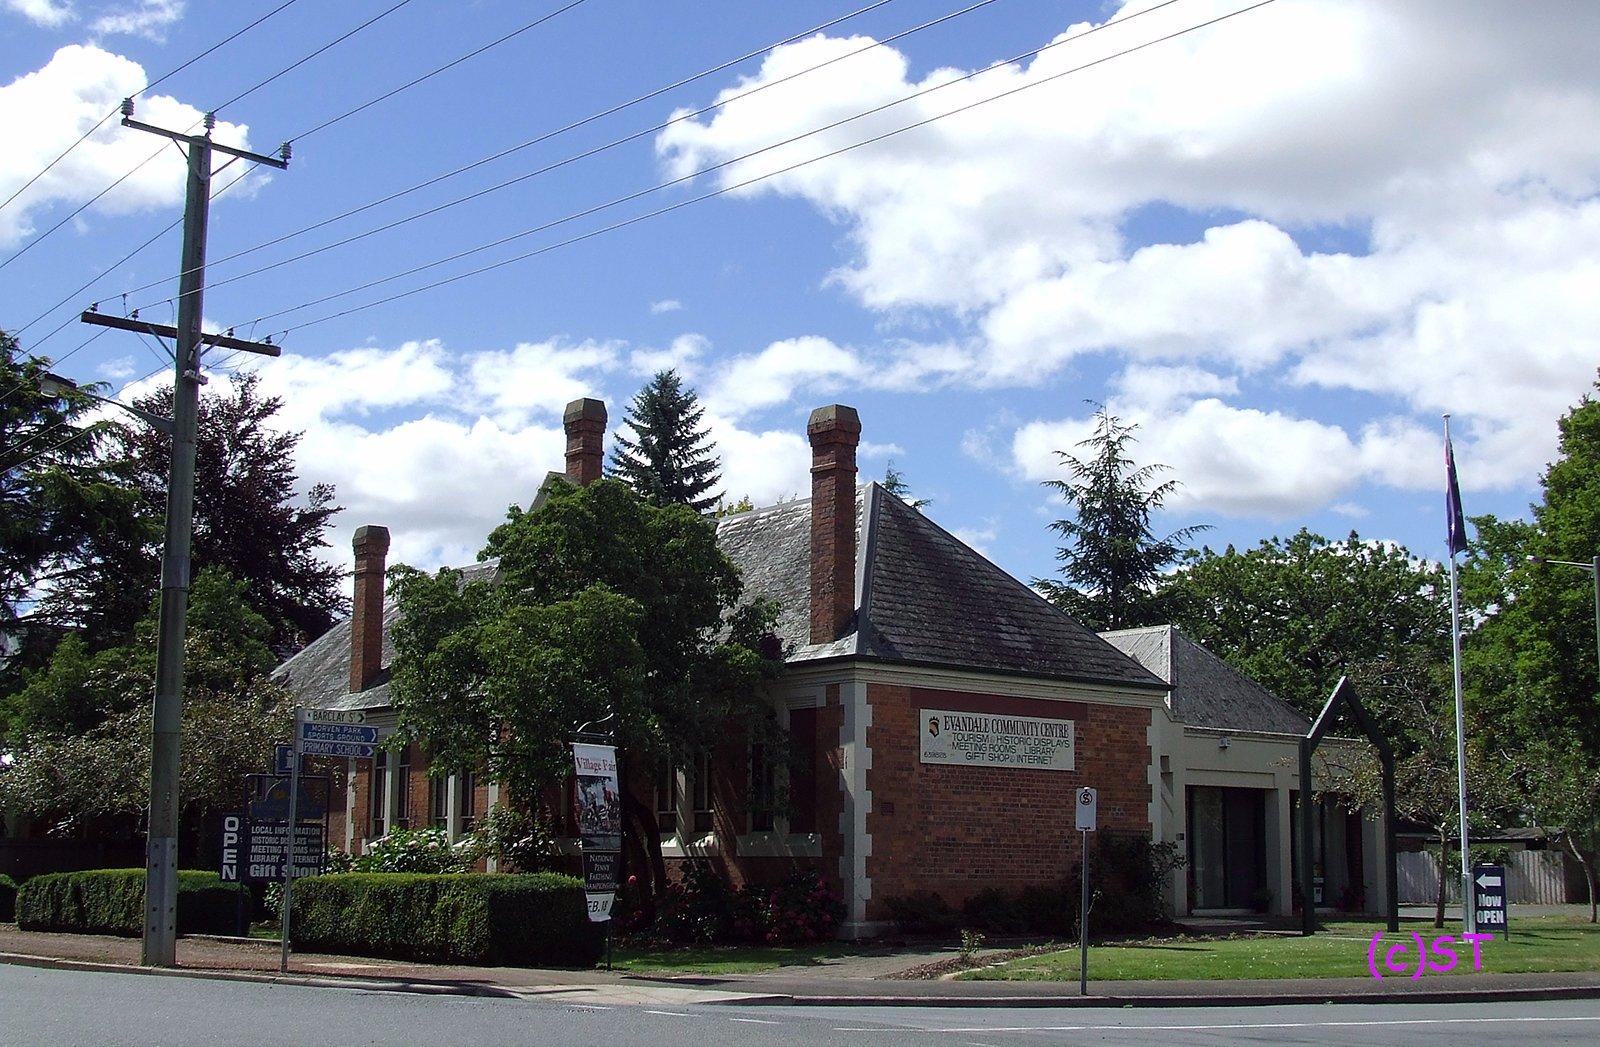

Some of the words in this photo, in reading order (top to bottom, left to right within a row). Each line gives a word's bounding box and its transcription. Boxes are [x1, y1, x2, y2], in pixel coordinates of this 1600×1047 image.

[313, 711, 344, 721] BARCLAY
[312, 725, 340, 733] MORVEN
[343, 726, 361, 734] PARK
[944, 716, 989, 733] EVANDALE
[992, 719, 1039, 736] COMMUNITY
[1040, 723, 1069, 738] CENTRE
[308, 732, 334, 740] SPORTS
[337, 733, 365, 742] GROUND
[952, 733, 989, 743] TOURISM
[996, 735, 1031, 746] HISTORIC
[1034, 737, 1070, 748] DISPLAYS
[304, 741, 333, 753] PRIMARY
[336, 744, 362, 755] SCHOOL
[952, 742, 987, 751] MEETING
[989, 744, 1016, 754] ROOMS
[1024, 746, 1056, 756] LIBRARY
[965, 752, 986, 761] GIFT
[988, 753, 1010, 763] SHOP
[1016, 755, 1053, 765] INTERNET
[576, 757, 601, 774] Village
[251, 826, 273, 834] LOCAL
[251, 836, 279, 844] HISTORIC
[222, 816, 240, 880] OPEN
[251, 845, 282, 853] MEETING
[250, 854, 281, 863] LIBRARY
[249, 864, 277, 877] Gift
[1477, 910, 1504, 924] OPEN
